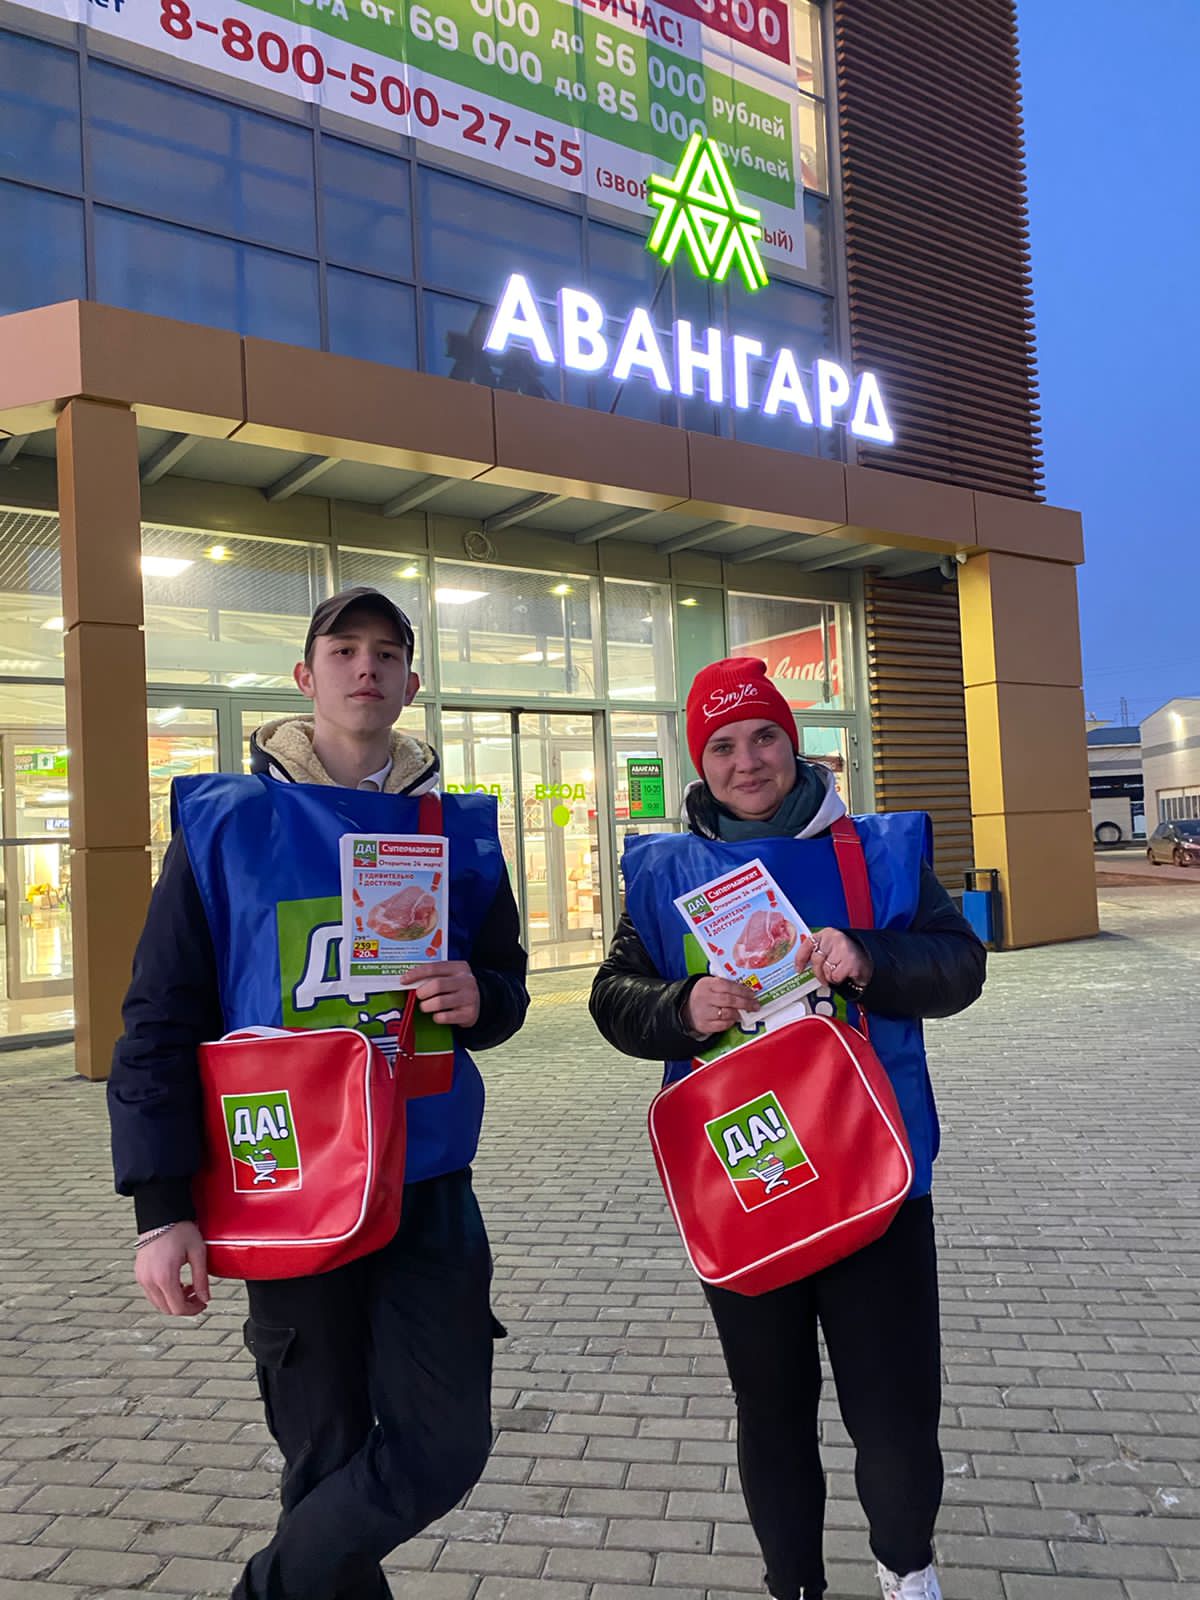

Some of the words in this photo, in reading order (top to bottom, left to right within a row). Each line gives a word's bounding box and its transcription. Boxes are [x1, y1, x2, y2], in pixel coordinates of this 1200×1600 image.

[159, 0, 583, 176] 8-800-500-27-55
[409, 4, 459, 51] 69
[472, 31, 543, 84] 000
[554, 76, 587, 102] до
[597, 81, 639, 122] 85
[551, 28, 584, 55] до
[596, 32, 637, 77] 56
[648, 56, 707, 104] 000
[712, 95, 786, 140] рублей
[481, 272, 897, 444] АВАНГАРД
[535, 783, 586, 801] ВХОД
[355, 843, 376, 855] ДА!
[382, 843, 440, 854] Супермаркет
[687, 898, 707, 913] ДА!
[232, 1104, 290, 1146] ДА!
[721, 1105, 788, 1168] ДА!
